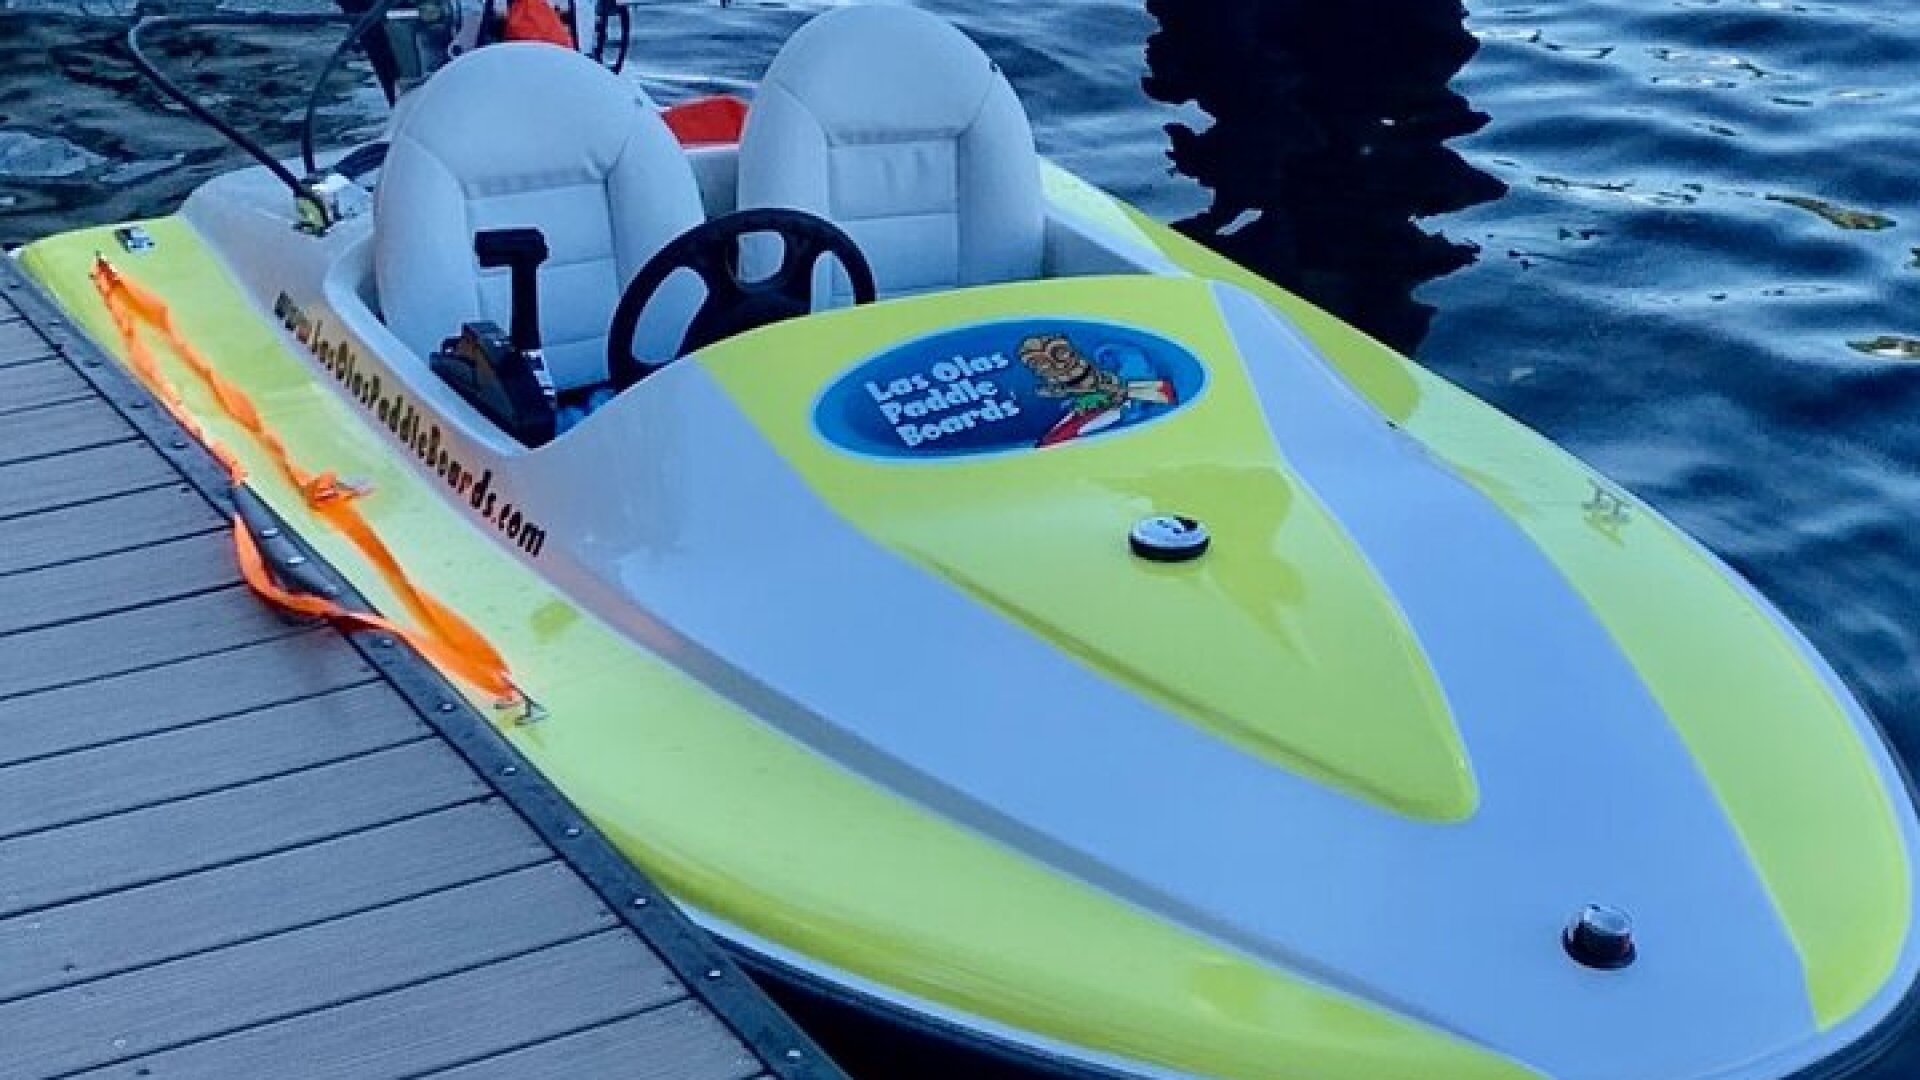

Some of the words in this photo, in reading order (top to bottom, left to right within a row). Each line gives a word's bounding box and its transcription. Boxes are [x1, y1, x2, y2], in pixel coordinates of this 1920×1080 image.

[865, 375, 929, 402] Las
[932, 352, 1009, 382] Olas
[880, 378, 998, 424] Paddle
[896, 397, 1020, 447] Boards
